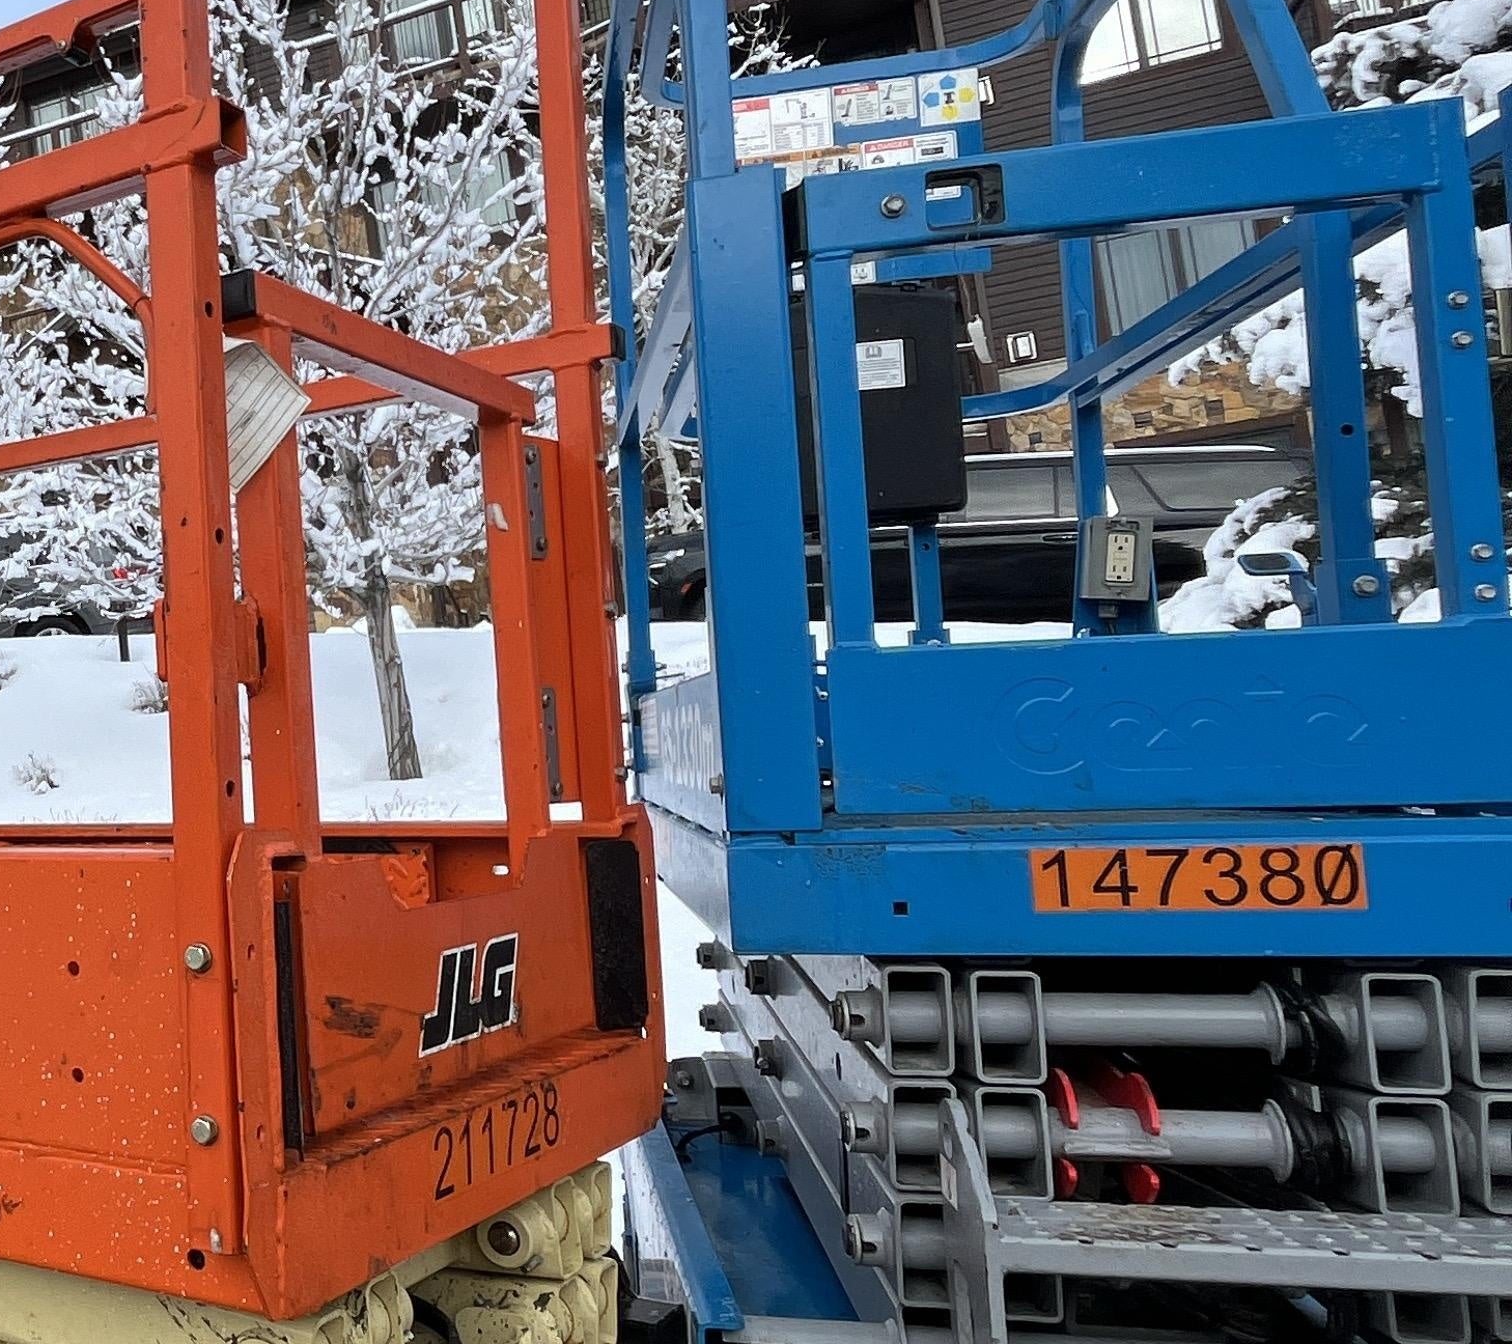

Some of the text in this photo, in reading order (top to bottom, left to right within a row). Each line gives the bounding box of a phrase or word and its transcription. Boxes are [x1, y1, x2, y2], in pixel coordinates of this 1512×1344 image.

[1040, 843, 1360, 909] 147380
[418, 931, 519, 1059] JLG
[432, 1084, 560, 1202] 211728
